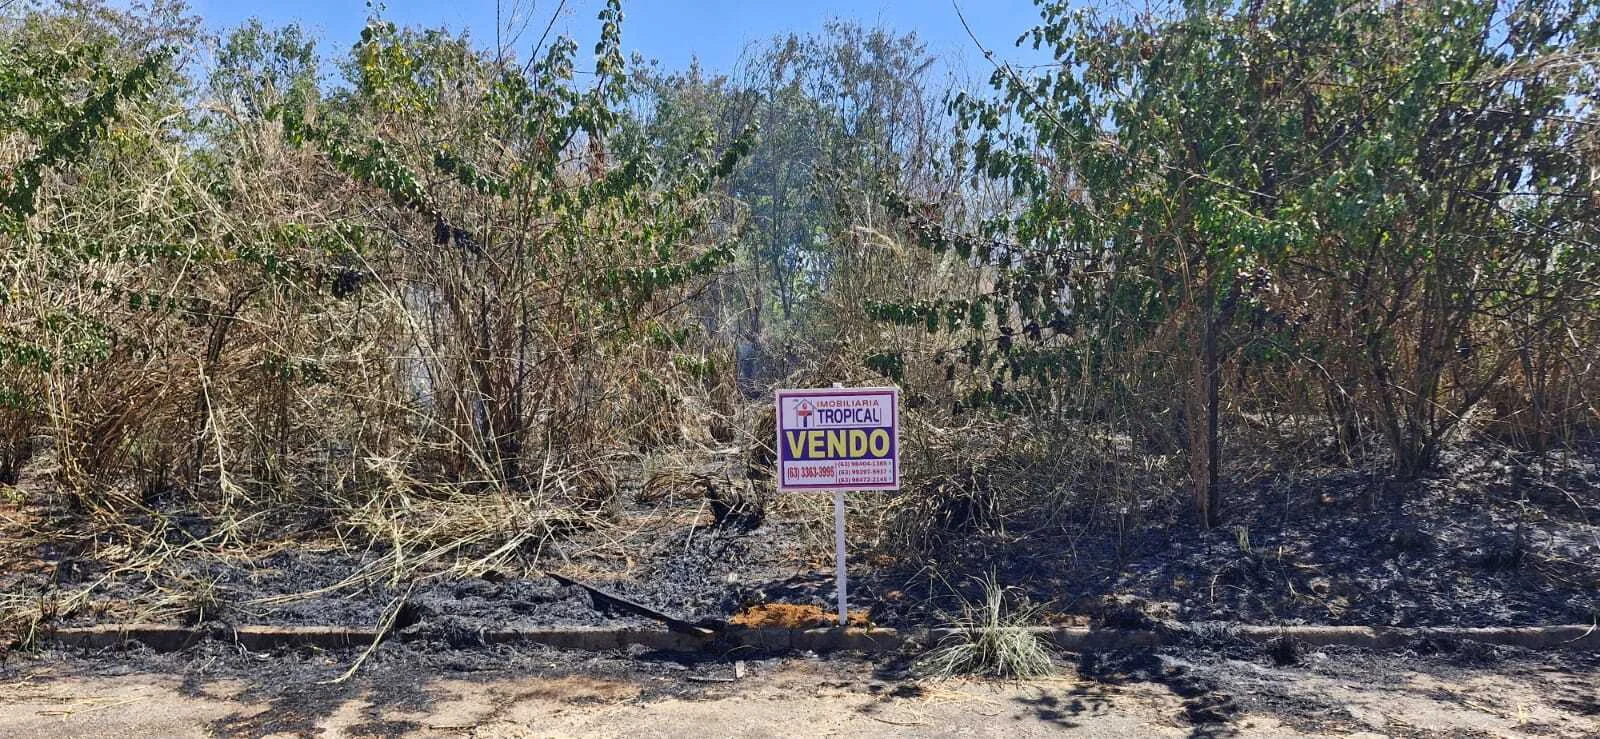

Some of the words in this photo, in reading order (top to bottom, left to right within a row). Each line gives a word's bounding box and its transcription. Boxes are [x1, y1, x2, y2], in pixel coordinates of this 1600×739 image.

[816, 399, 879, 408] IMOBILIARIA
[818, 408, 879, 423] TROPICAL
[786, 428, 889, 459] VENDO
[788, 467, 799, 480] (63)
[801, 466, 834, 478] 3363-3995
